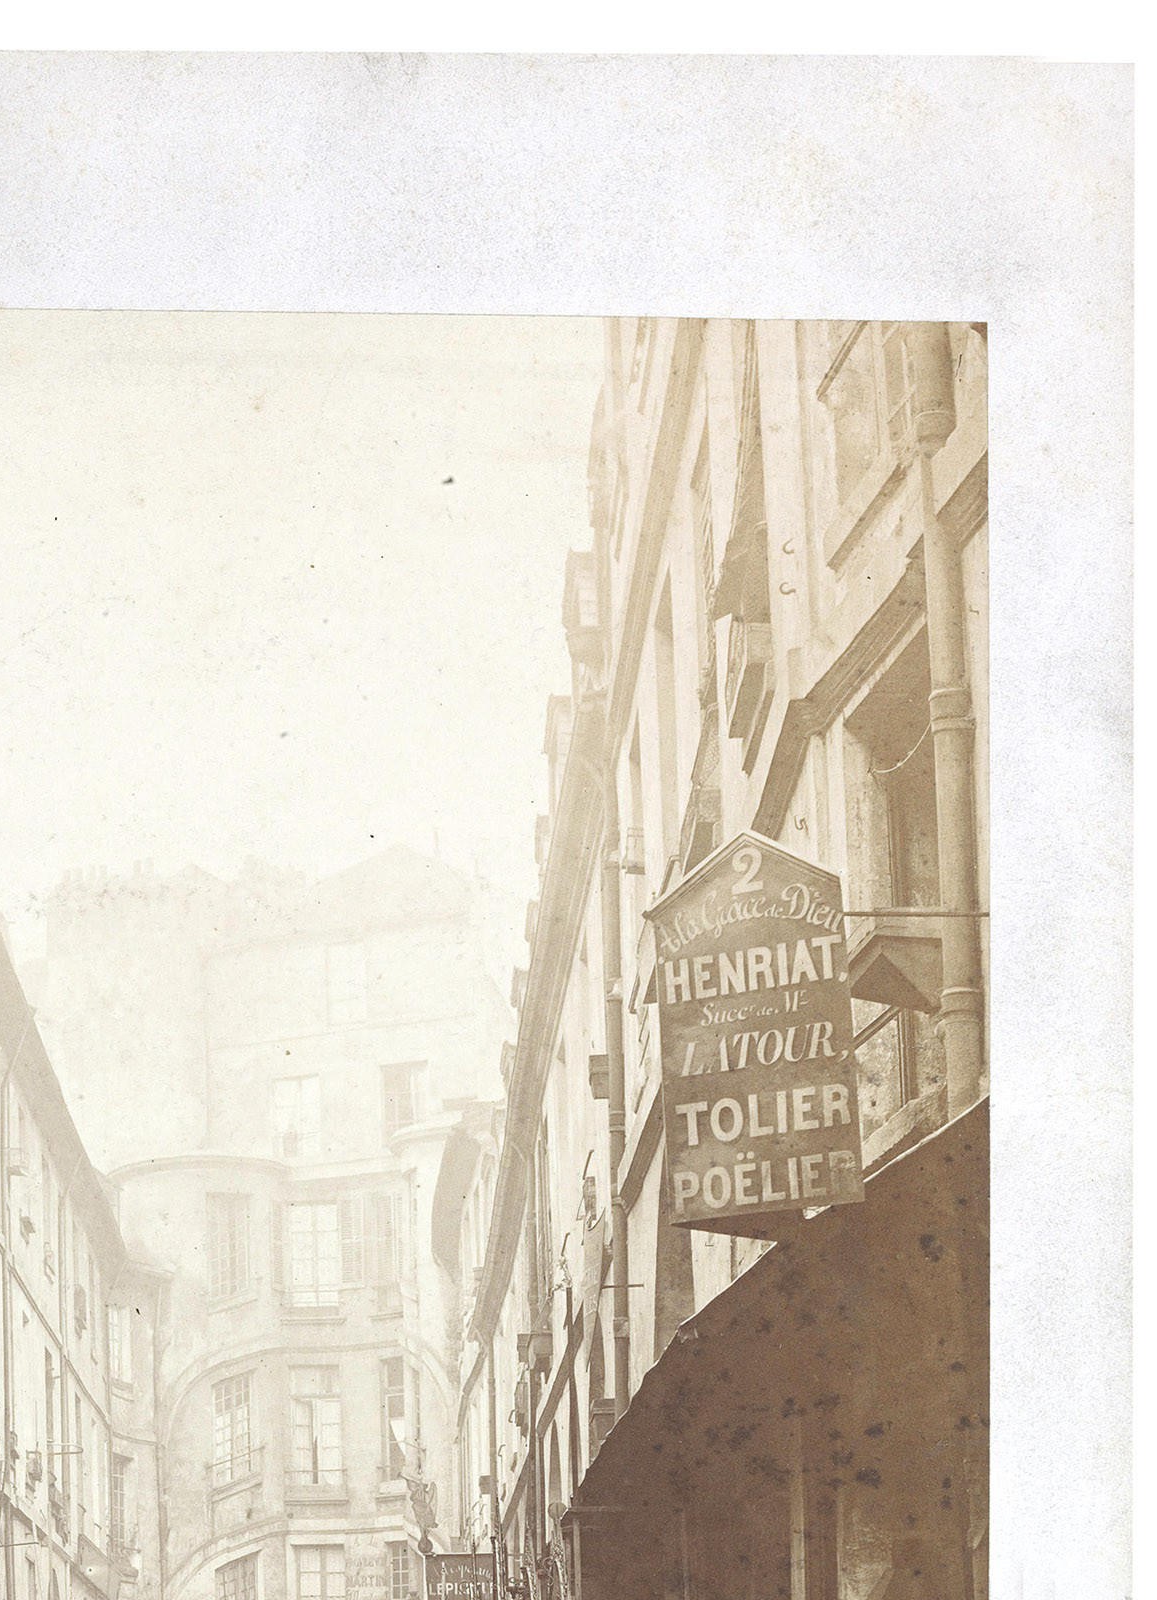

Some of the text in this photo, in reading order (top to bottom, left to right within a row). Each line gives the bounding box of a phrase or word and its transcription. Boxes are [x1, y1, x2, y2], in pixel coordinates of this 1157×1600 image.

[732, 847, 764, 895] 2
[660, 925, 681, 953] A
[675, 912, 703, 945] la
[764, 904, 783, 918] de
[782, 883, 844, 933] Dieu
[675, 1083, 852, 1146] TOLIER
[673, 1151, 859, 1214] POËLIER
